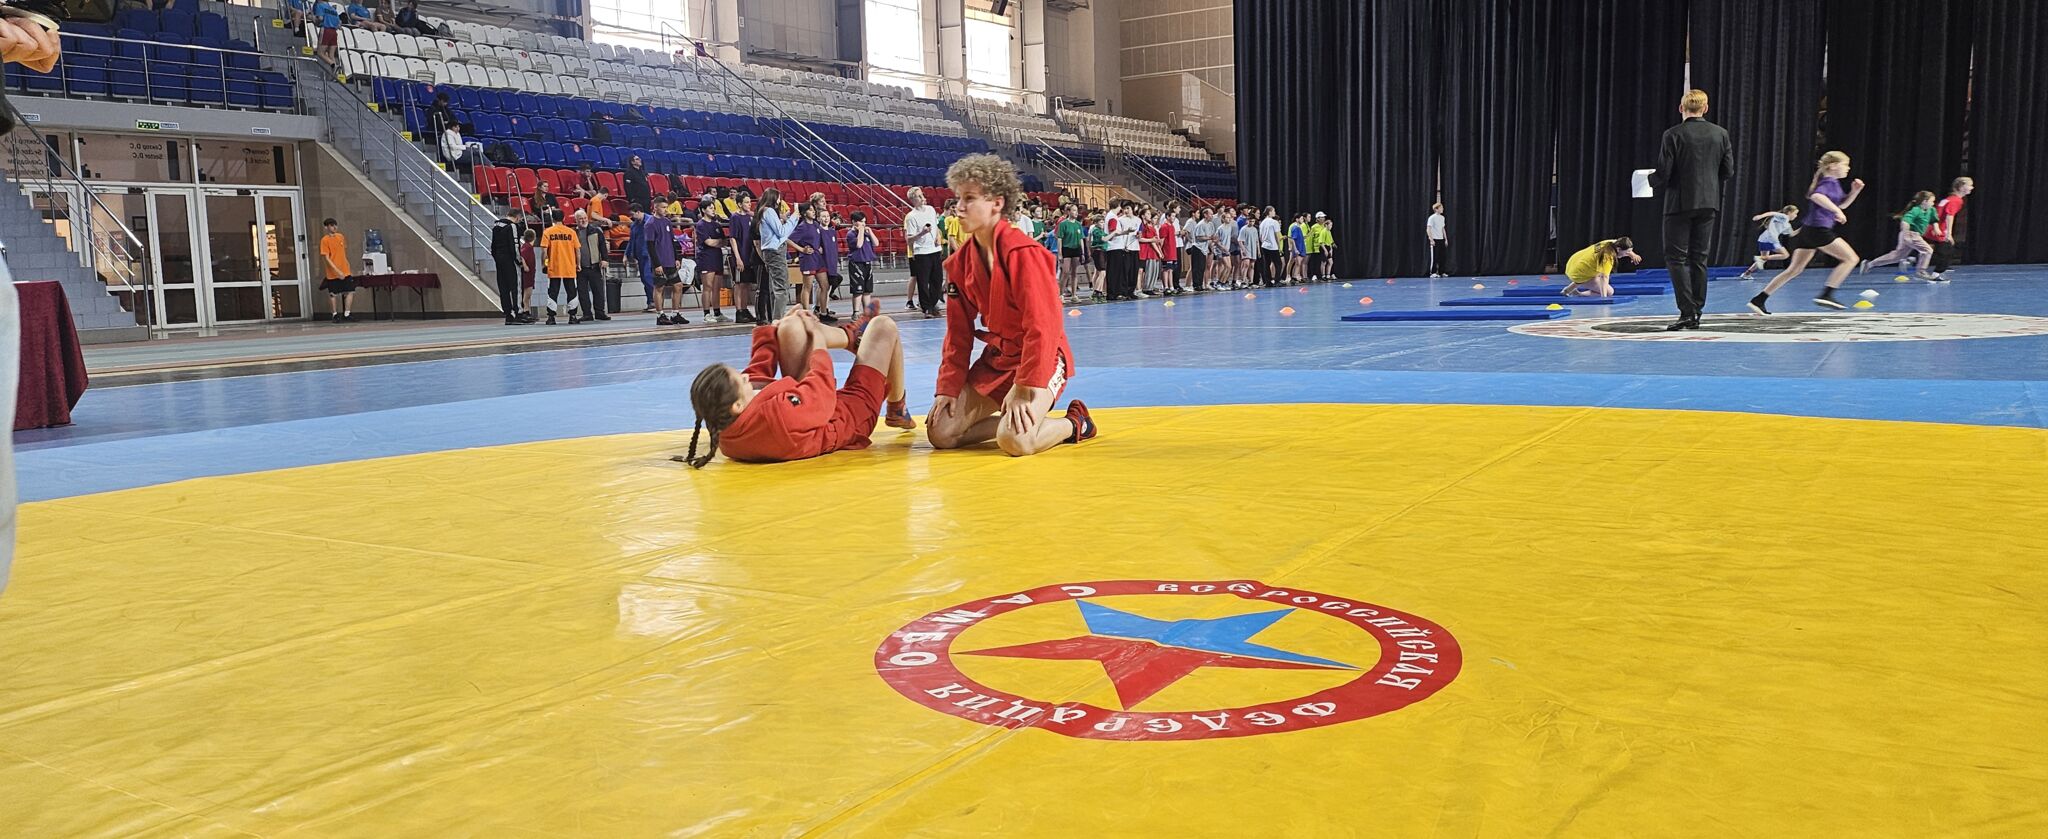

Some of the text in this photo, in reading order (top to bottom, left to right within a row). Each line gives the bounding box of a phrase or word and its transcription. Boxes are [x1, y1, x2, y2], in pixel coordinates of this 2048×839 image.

[549, 233, 573, 241] САМБО
[889, 585, 1097, 666] САМБО
[924, 682, 1337, 733] ФЕДЕРАЦИЯ
